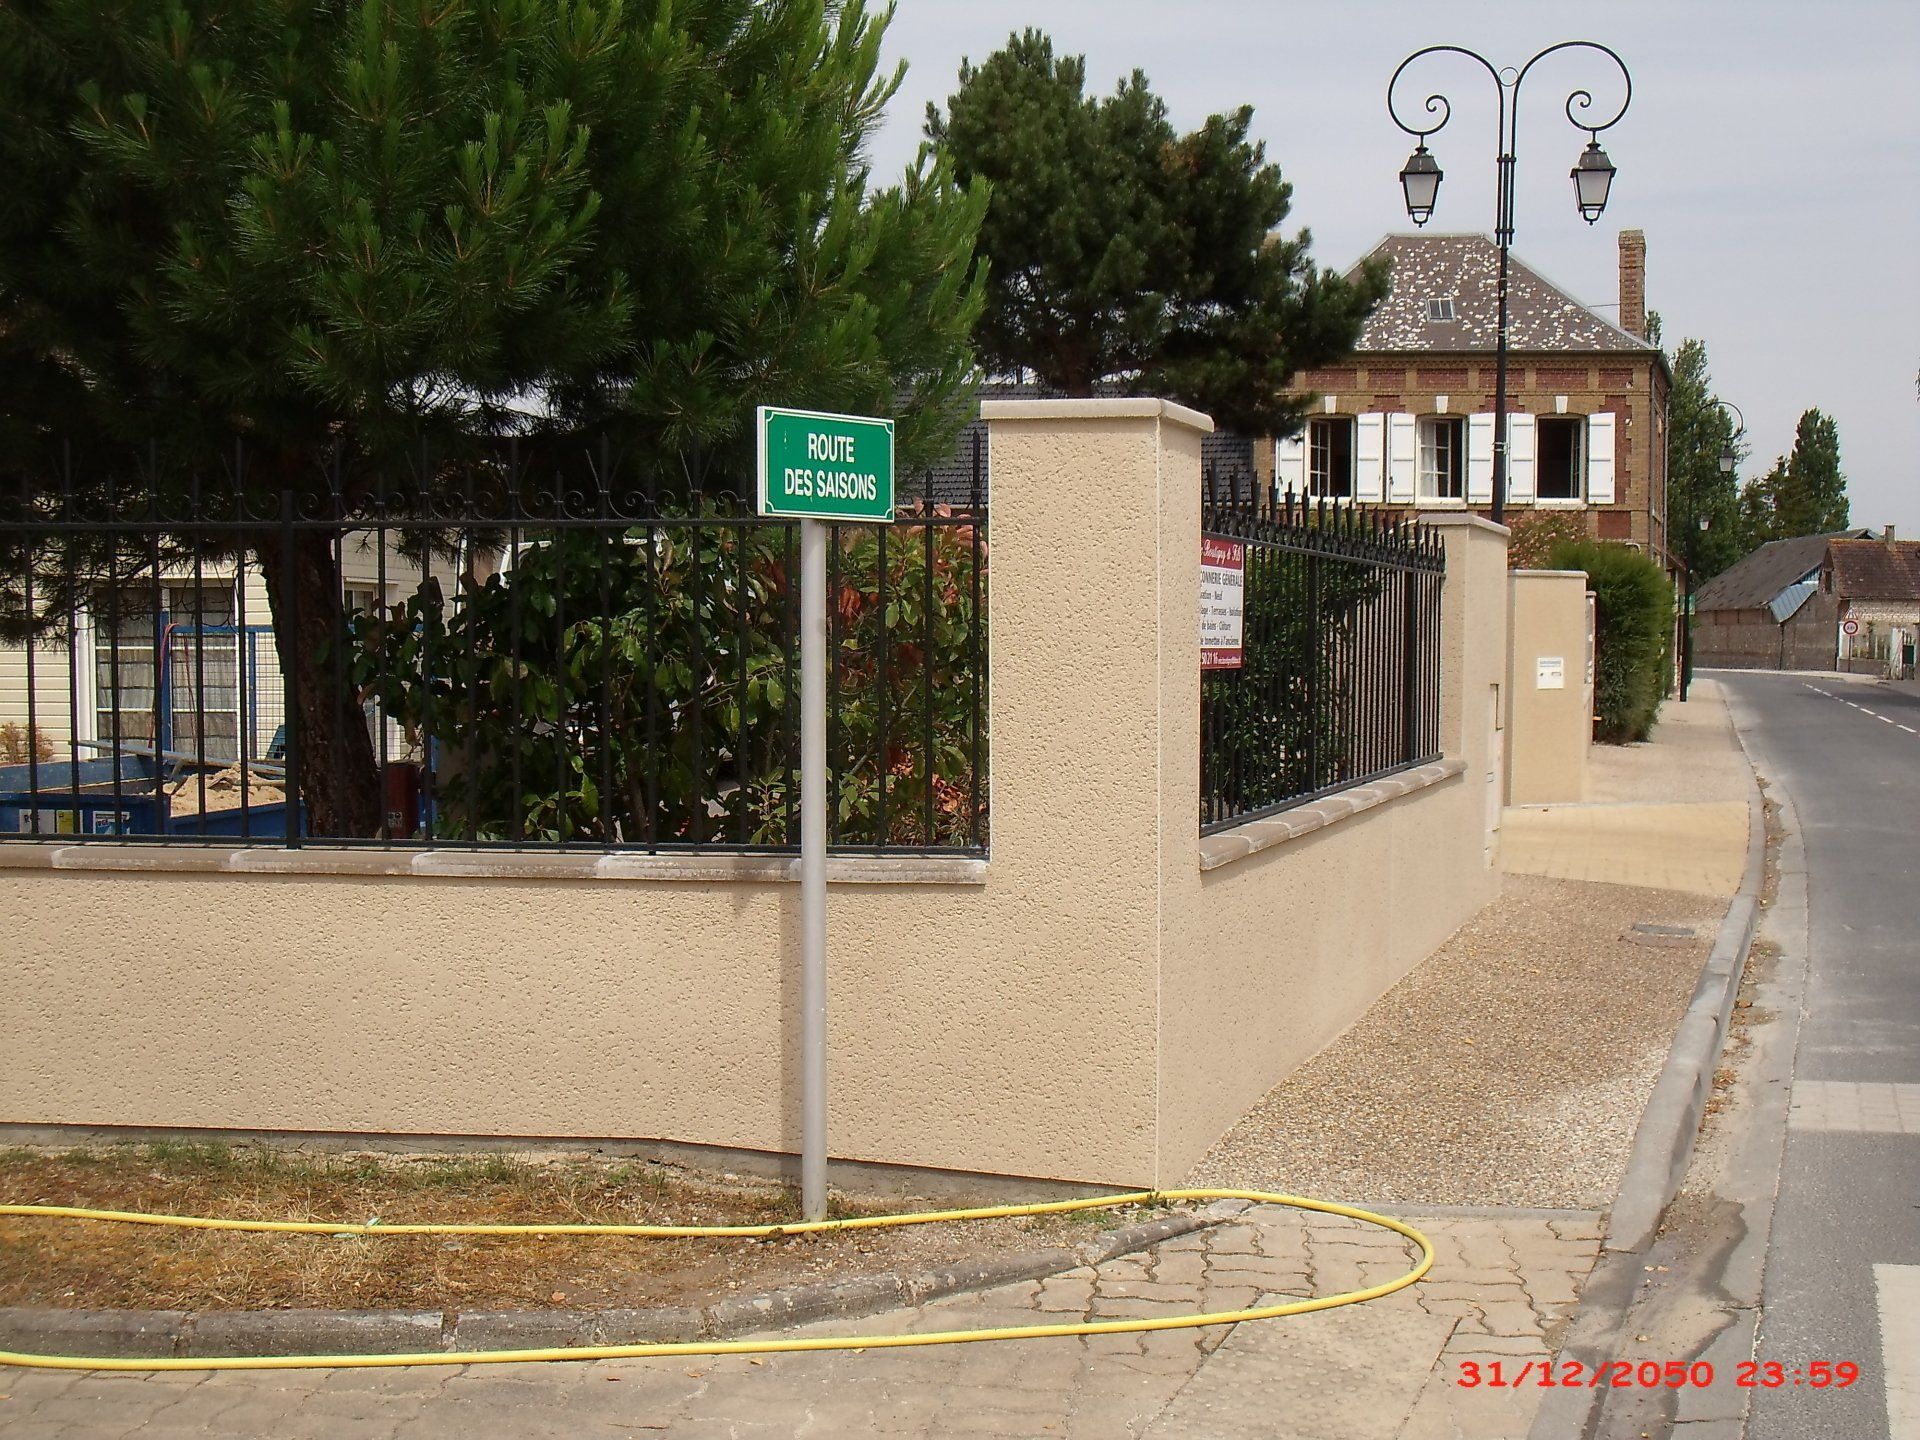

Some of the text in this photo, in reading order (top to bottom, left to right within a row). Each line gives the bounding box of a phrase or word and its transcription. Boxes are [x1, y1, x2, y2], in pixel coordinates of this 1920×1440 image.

[808, 432, 855, 463] ROUTE
[784, 468, 877, 501] DES SAISONS
